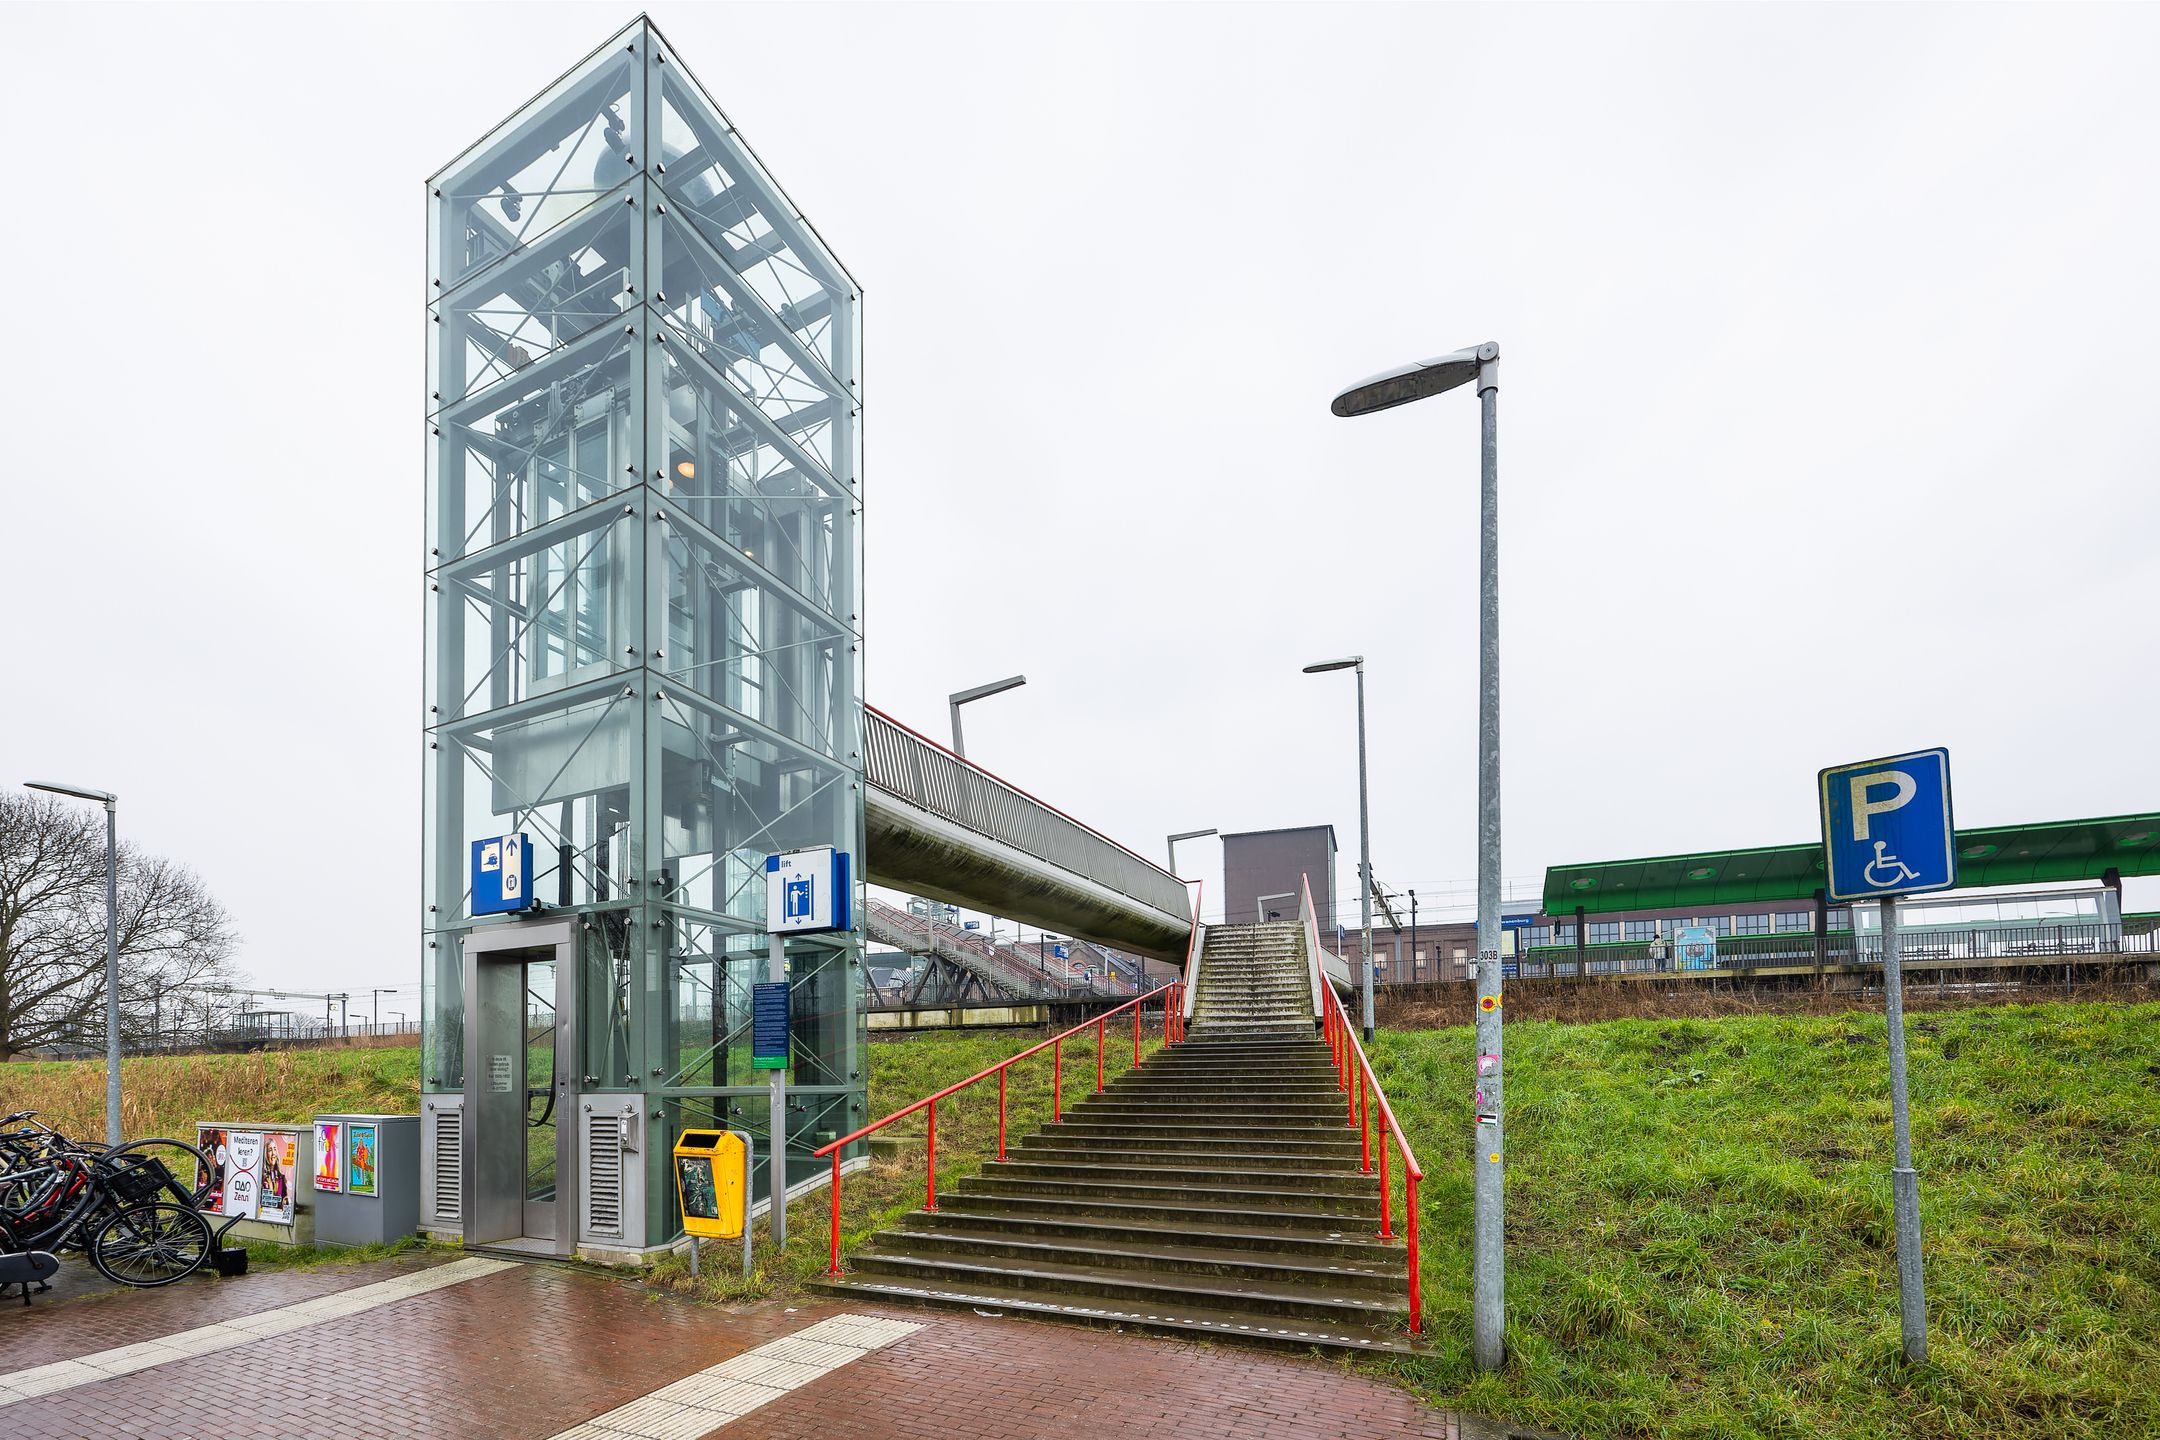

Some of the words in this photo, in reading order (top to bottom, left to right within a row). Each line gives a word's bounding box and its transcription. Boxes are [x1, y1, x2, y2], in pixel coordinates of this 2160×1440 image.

[1850, 770, 1917, 841] P
[781, 860, 792, 868] lift
[1480, 950, 1498, 960] 303B
[233, 1136, 259, 1146] Mediteren
[237, 1147, 254, 1157] leren?
